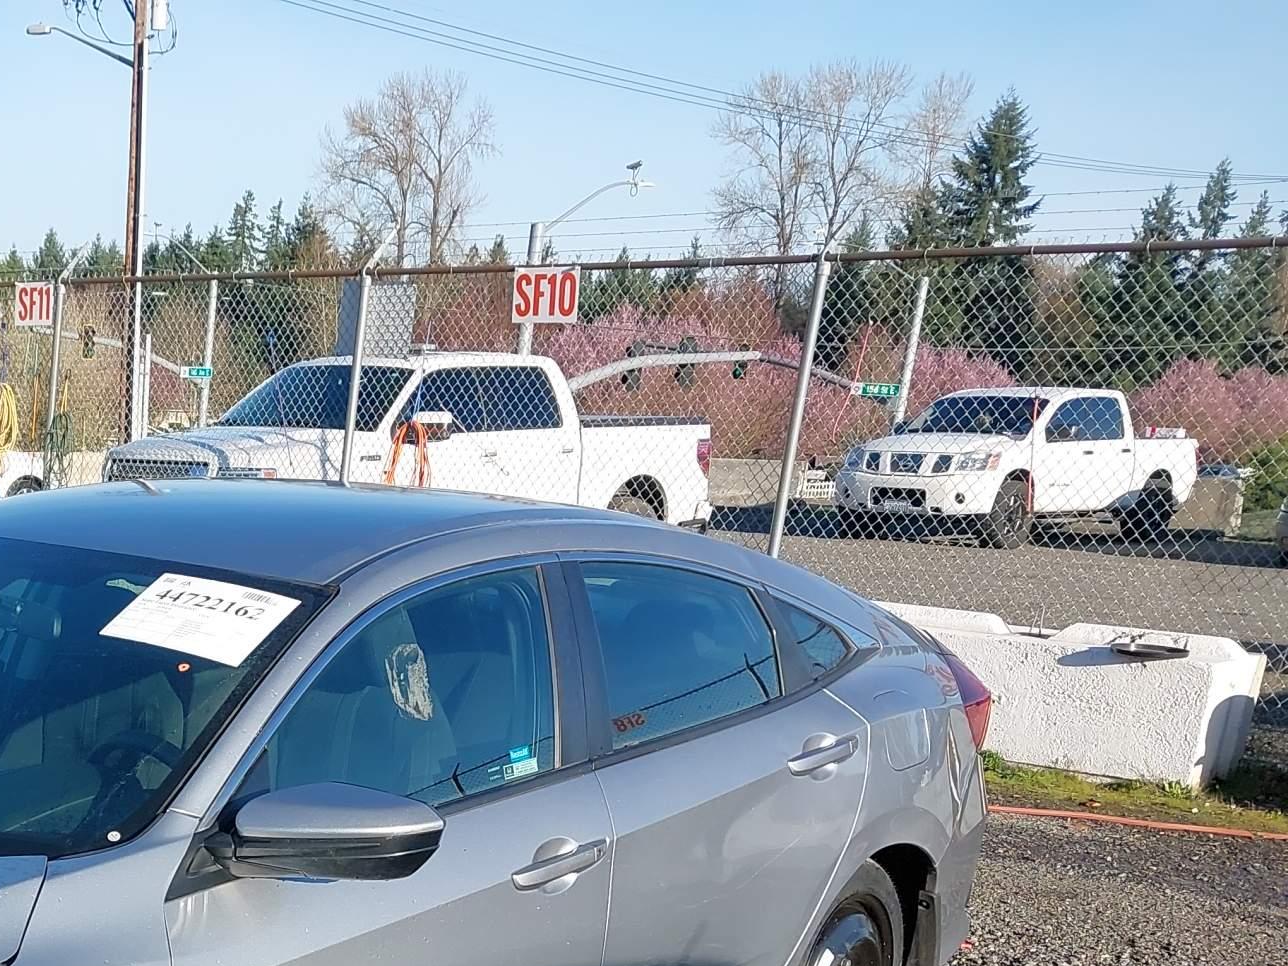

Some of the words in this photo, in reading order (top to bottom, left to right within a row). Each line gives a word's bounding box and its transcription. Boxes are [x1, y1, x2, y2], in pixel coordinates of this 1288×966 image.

[18, 287, 51, 321] SF11
[515, 272, 577, 317] SF10
[155, 588, 265, 621] 44722162
